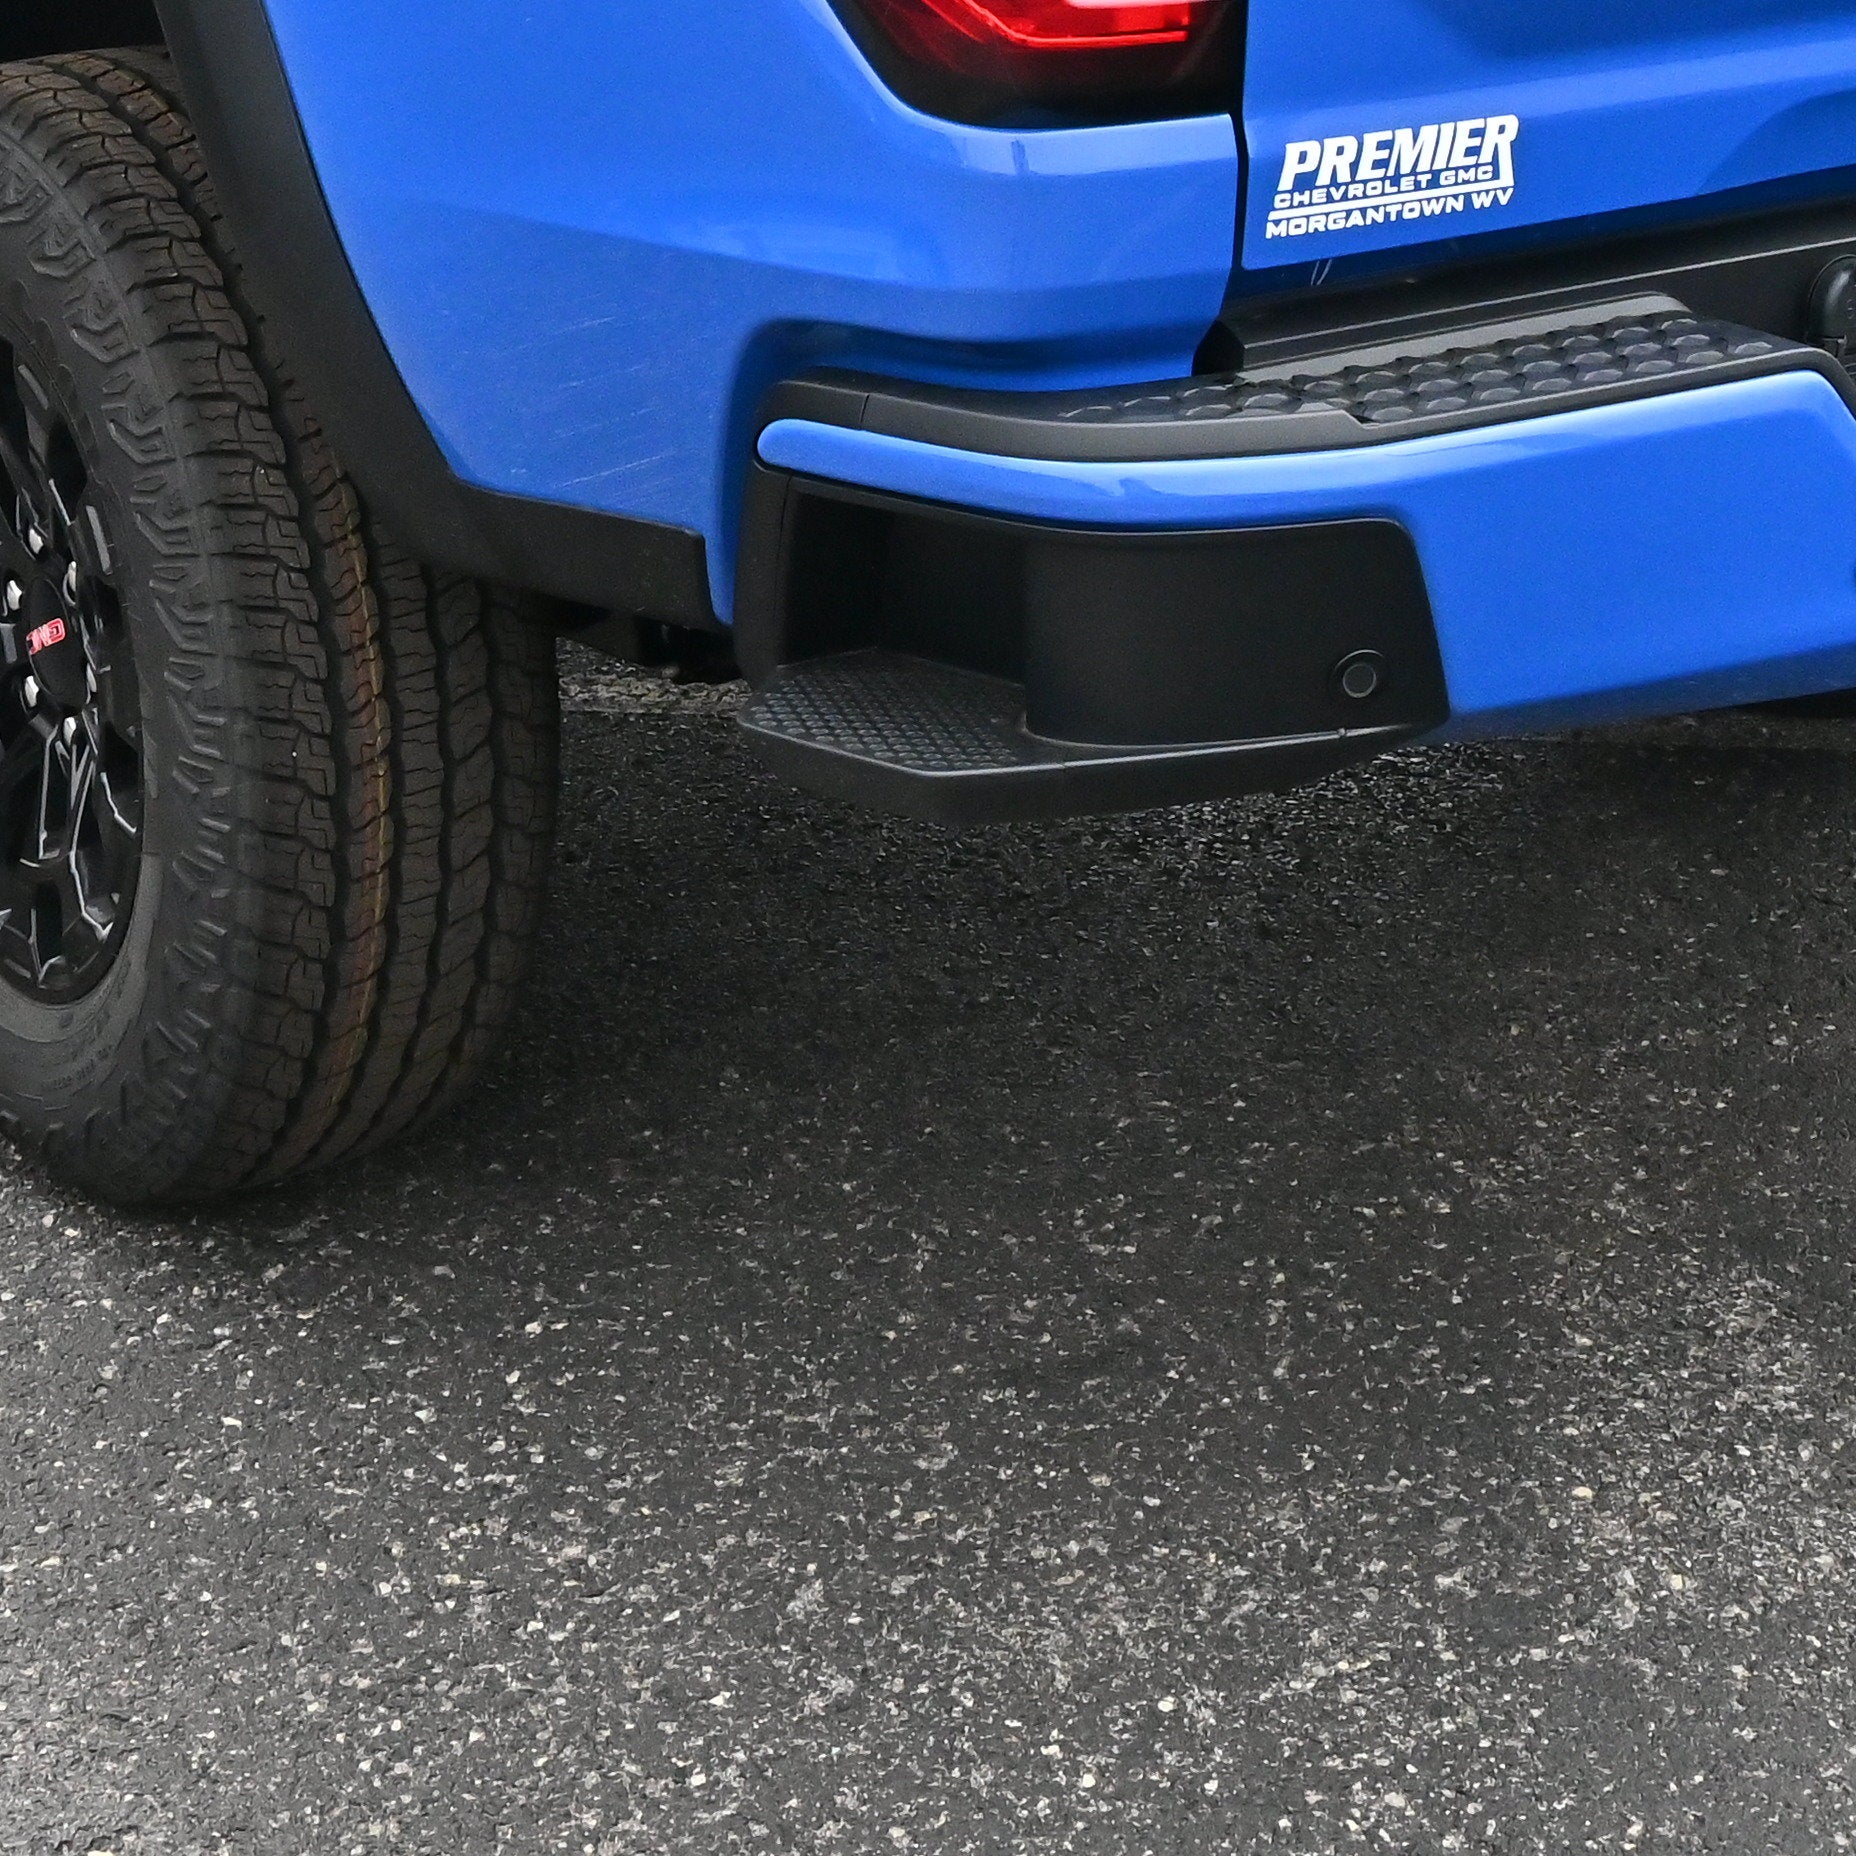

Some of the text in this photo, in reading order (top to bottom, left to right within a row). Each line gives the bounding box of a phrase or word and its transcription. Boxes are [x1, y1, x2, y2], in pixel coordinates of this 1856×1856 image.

[1276, 114, 1520, 191] PREMIER
[1274, 164, 1494, 209] CHEVROLET GMC
[1265, 187, 1515, 240] MORGANTOWN WV
